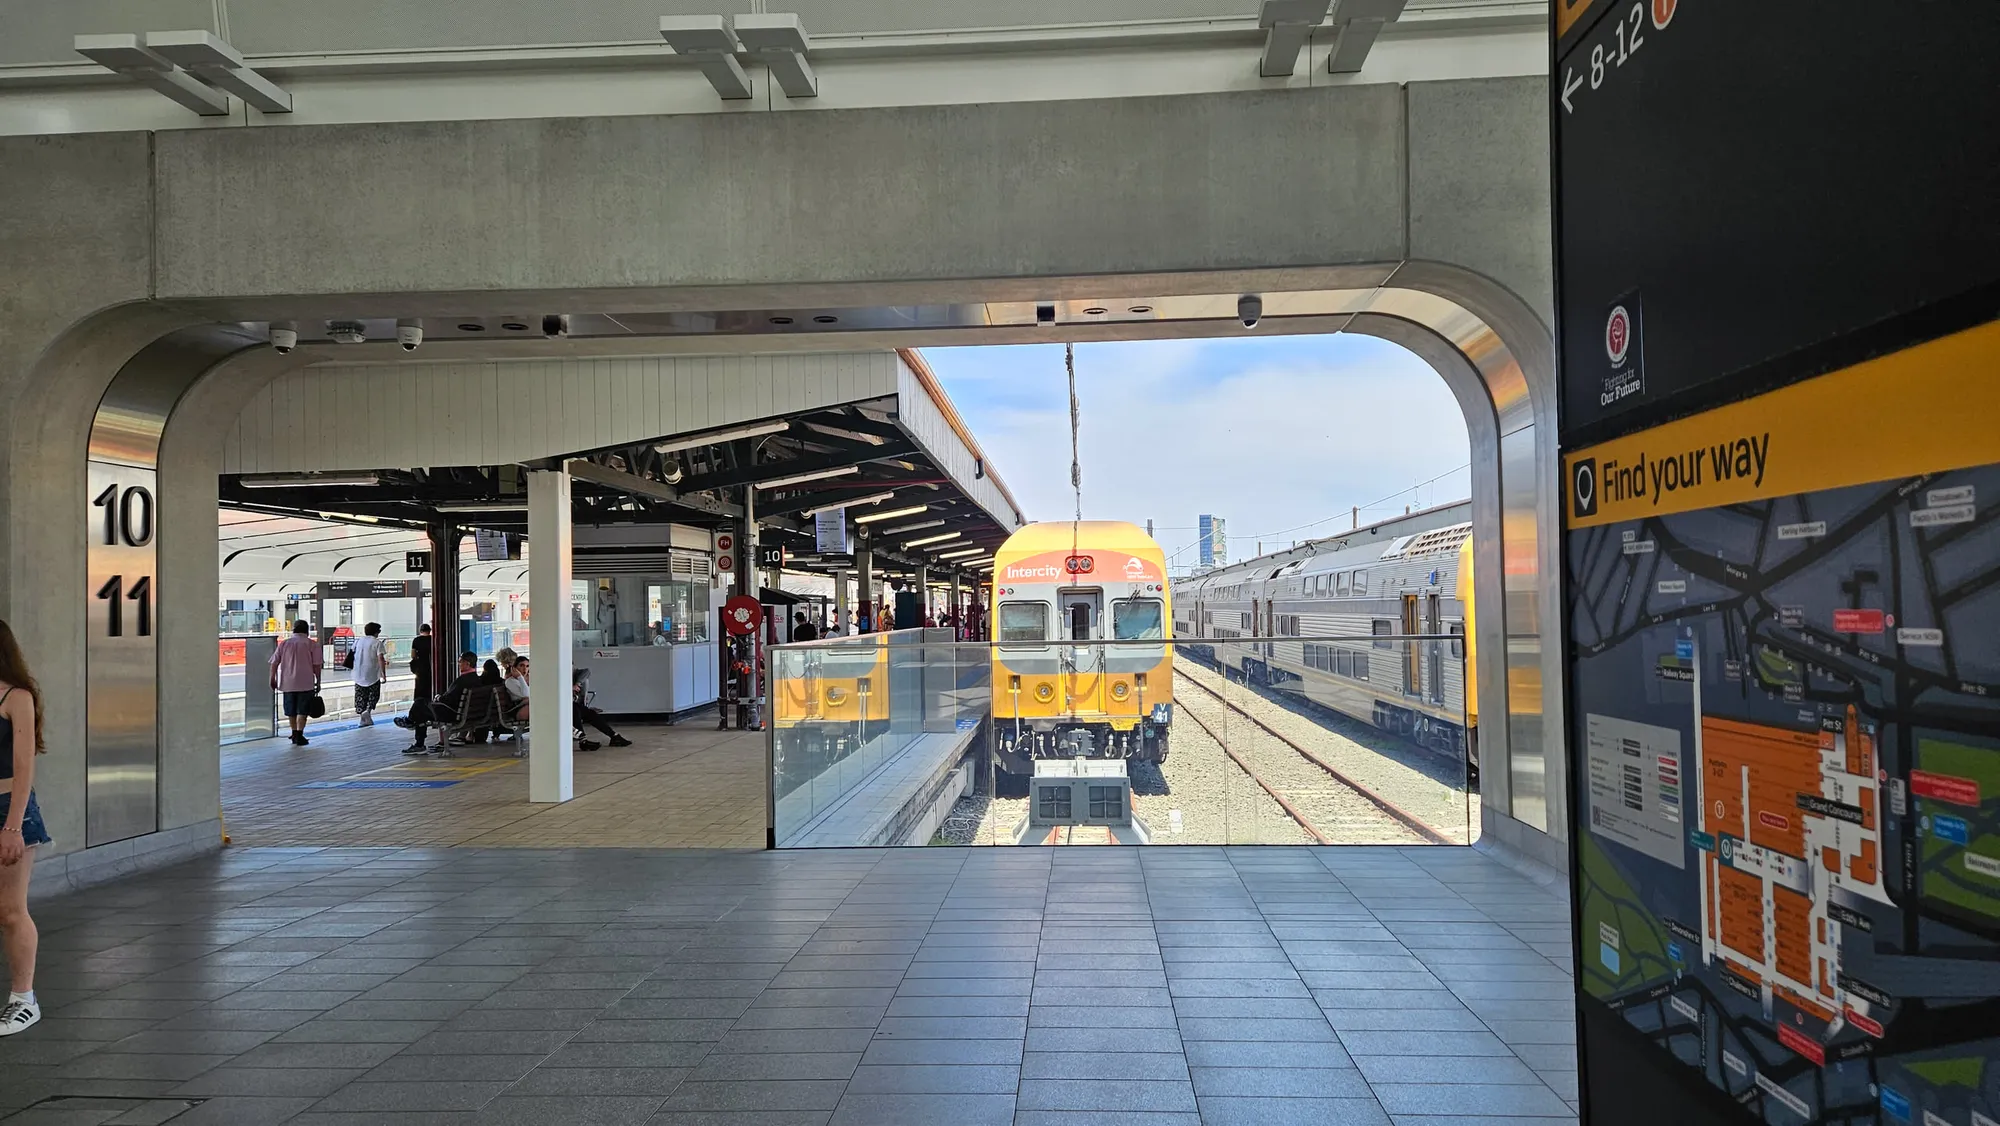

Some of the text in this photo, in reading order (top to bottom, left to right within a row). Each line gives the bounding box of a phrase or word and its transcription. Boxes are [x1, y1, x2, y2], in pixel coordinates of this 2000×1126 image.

[1590, 2, 1644, 90] 8-12
[1600, 379, 1641, 406] Our Future
[1603, 432, 1769, 506] Find your way
[92, 483, 154, 547] 10
[409, 556, 424, 568] 11
[764, 550, 780, 562] 10
[1007, 564, 1062, 580] Intercity
[96, 574, 151, 637] 11
[1663, 668, 1694, 680] Railway Square
[1155, 710, 1168, 723] 41
[1822, 718, 1842, 731] Pitt St
[1809, 799, 1862, 821] Grand Concourse
[1841, 910, 1871, 929] Eddy Ave
[1671, 922, 1694, 942] Devonshire
[1694, 933, 1701, 944] St
[1728, 976, 1751, 996] Chalmers
[1751, 986, 1758, 999] St
[1851, 981, 1891, 1007] Elizabeth St
